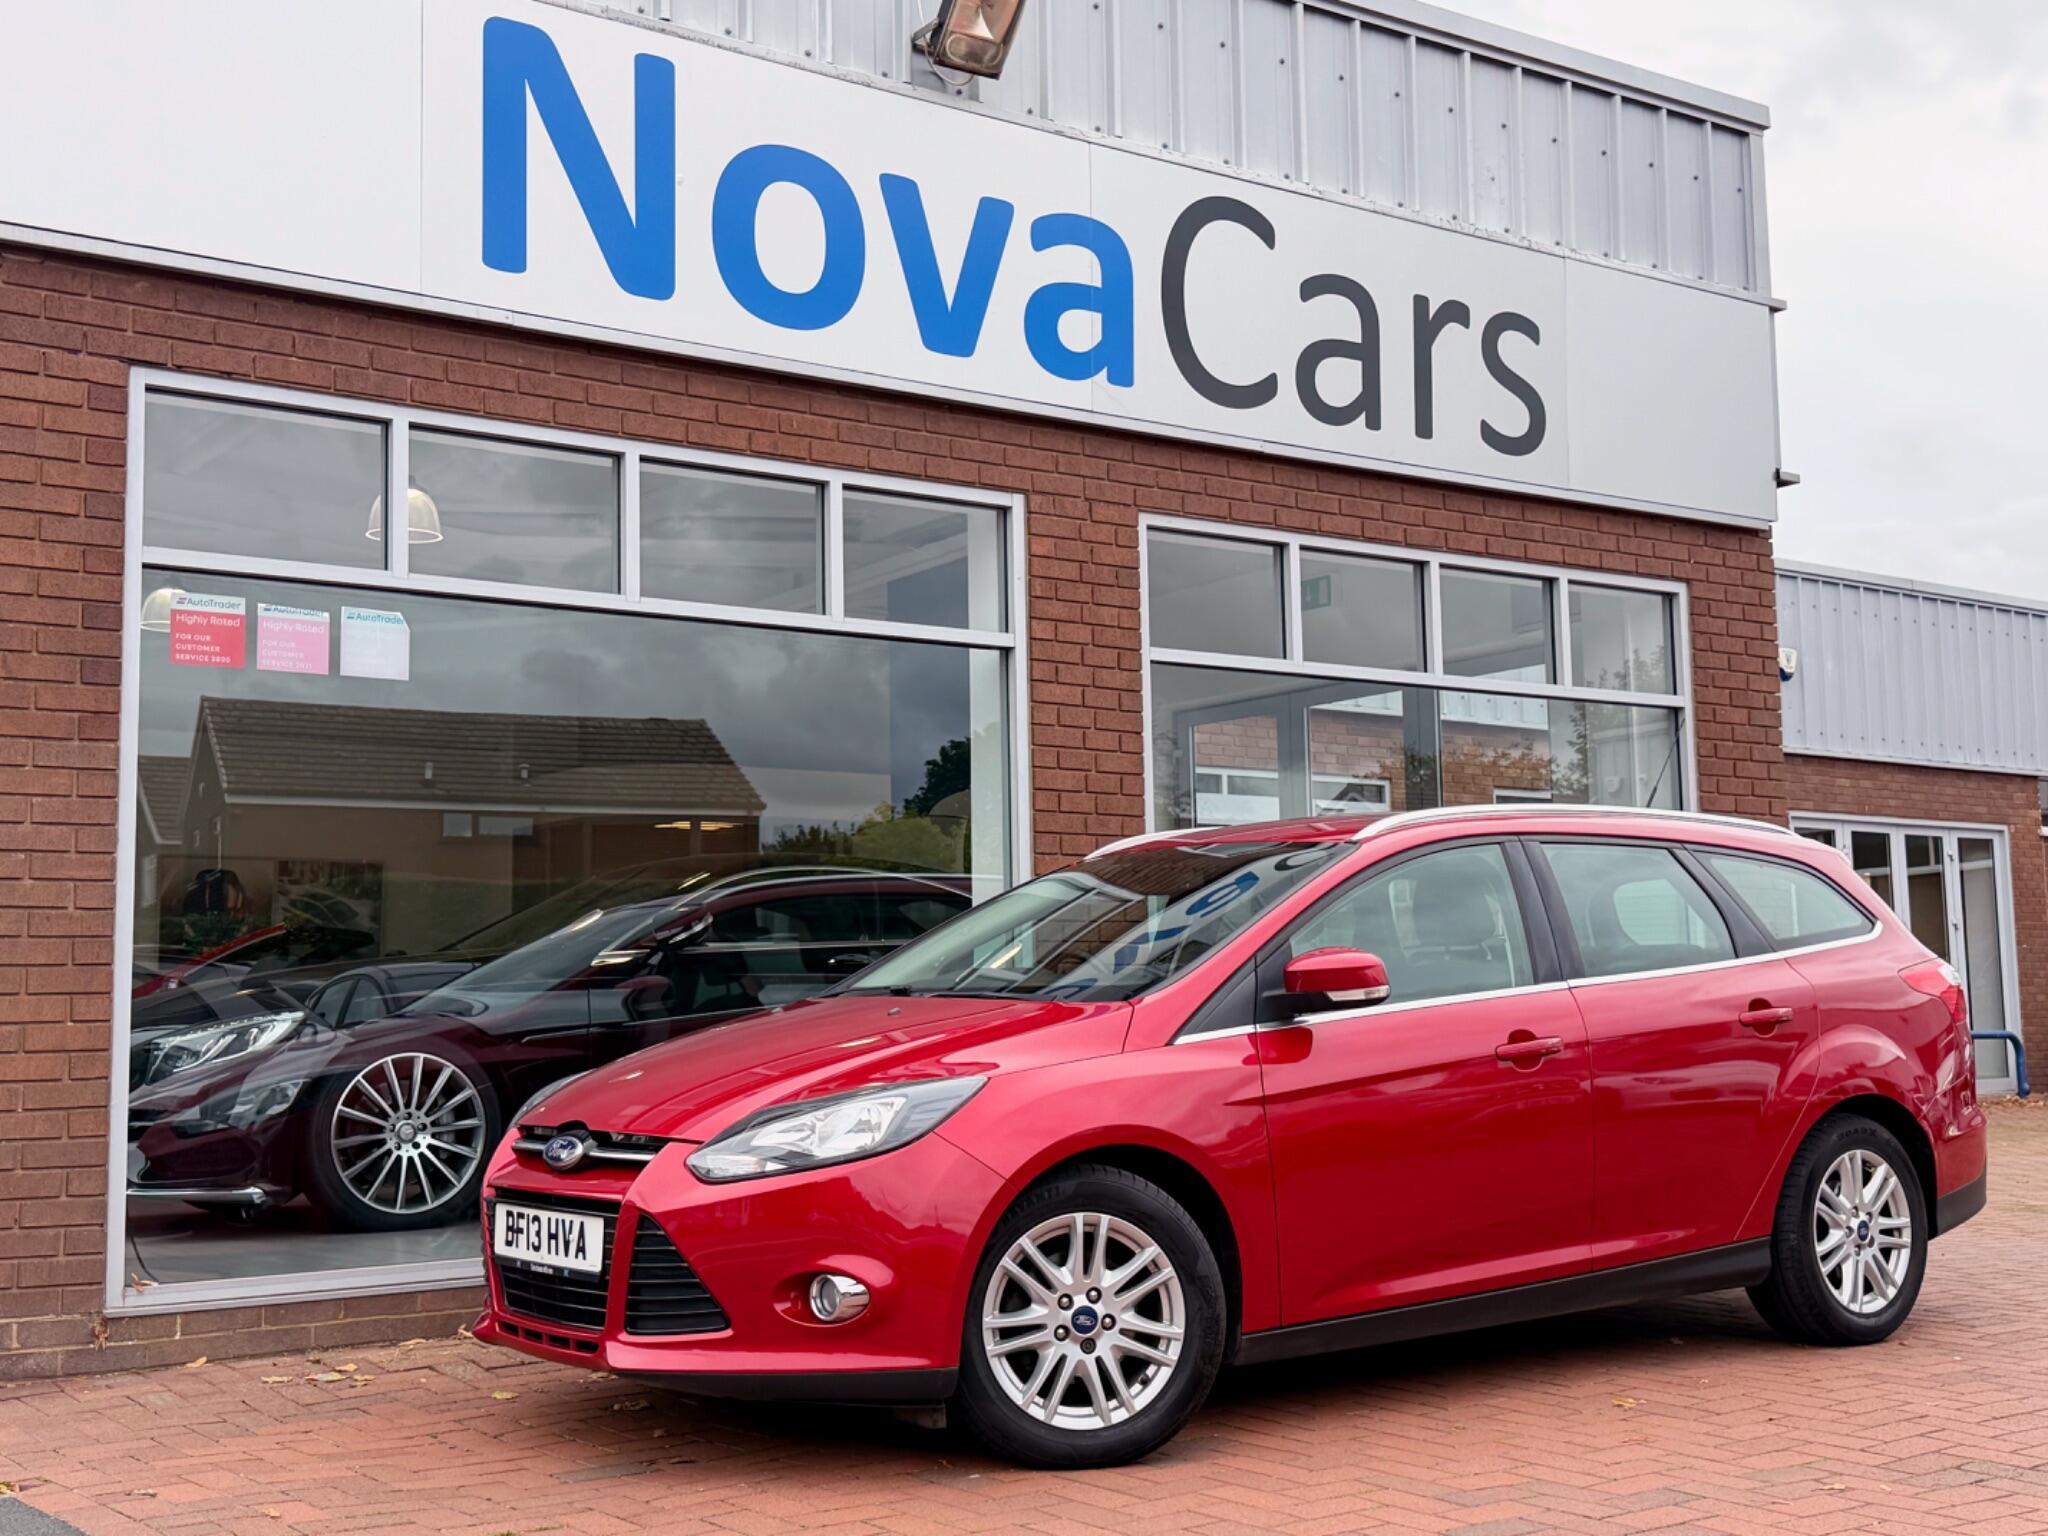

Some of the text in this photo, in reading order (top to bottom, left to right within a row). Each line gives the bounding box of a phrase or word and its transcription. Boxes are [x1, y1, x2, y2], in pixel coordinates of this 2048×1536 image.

[187, 597, 241, 610] AutoTrader
[176, 613, 240, 627] Highly Rated
[175, 632, 211, 642] FOR OUR
[175, 642, 220, 653] CUSTOMER
[505, 1210, 586, 1261] BF13 HVA
